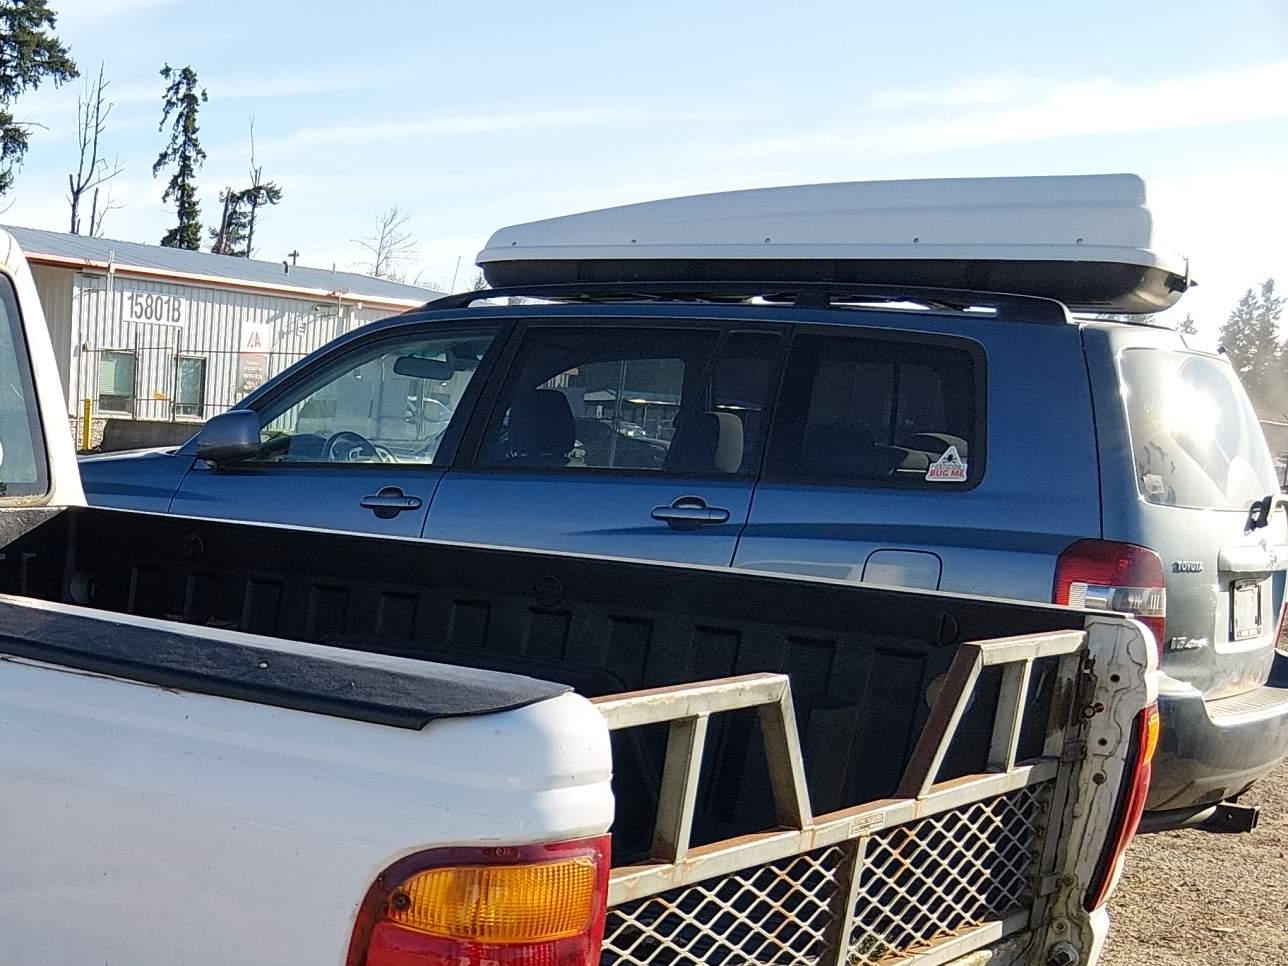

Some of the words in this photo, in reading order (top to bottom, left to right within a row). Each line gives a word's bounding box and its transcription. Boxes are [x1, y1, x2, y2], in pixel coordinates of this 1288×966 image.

[126, 293, 182, 323] 15801B
[929, 469, 949, 477] BUG
[951, 469, 965, 477] ME
[1176, 560, 1203, 572] TOYOTA
